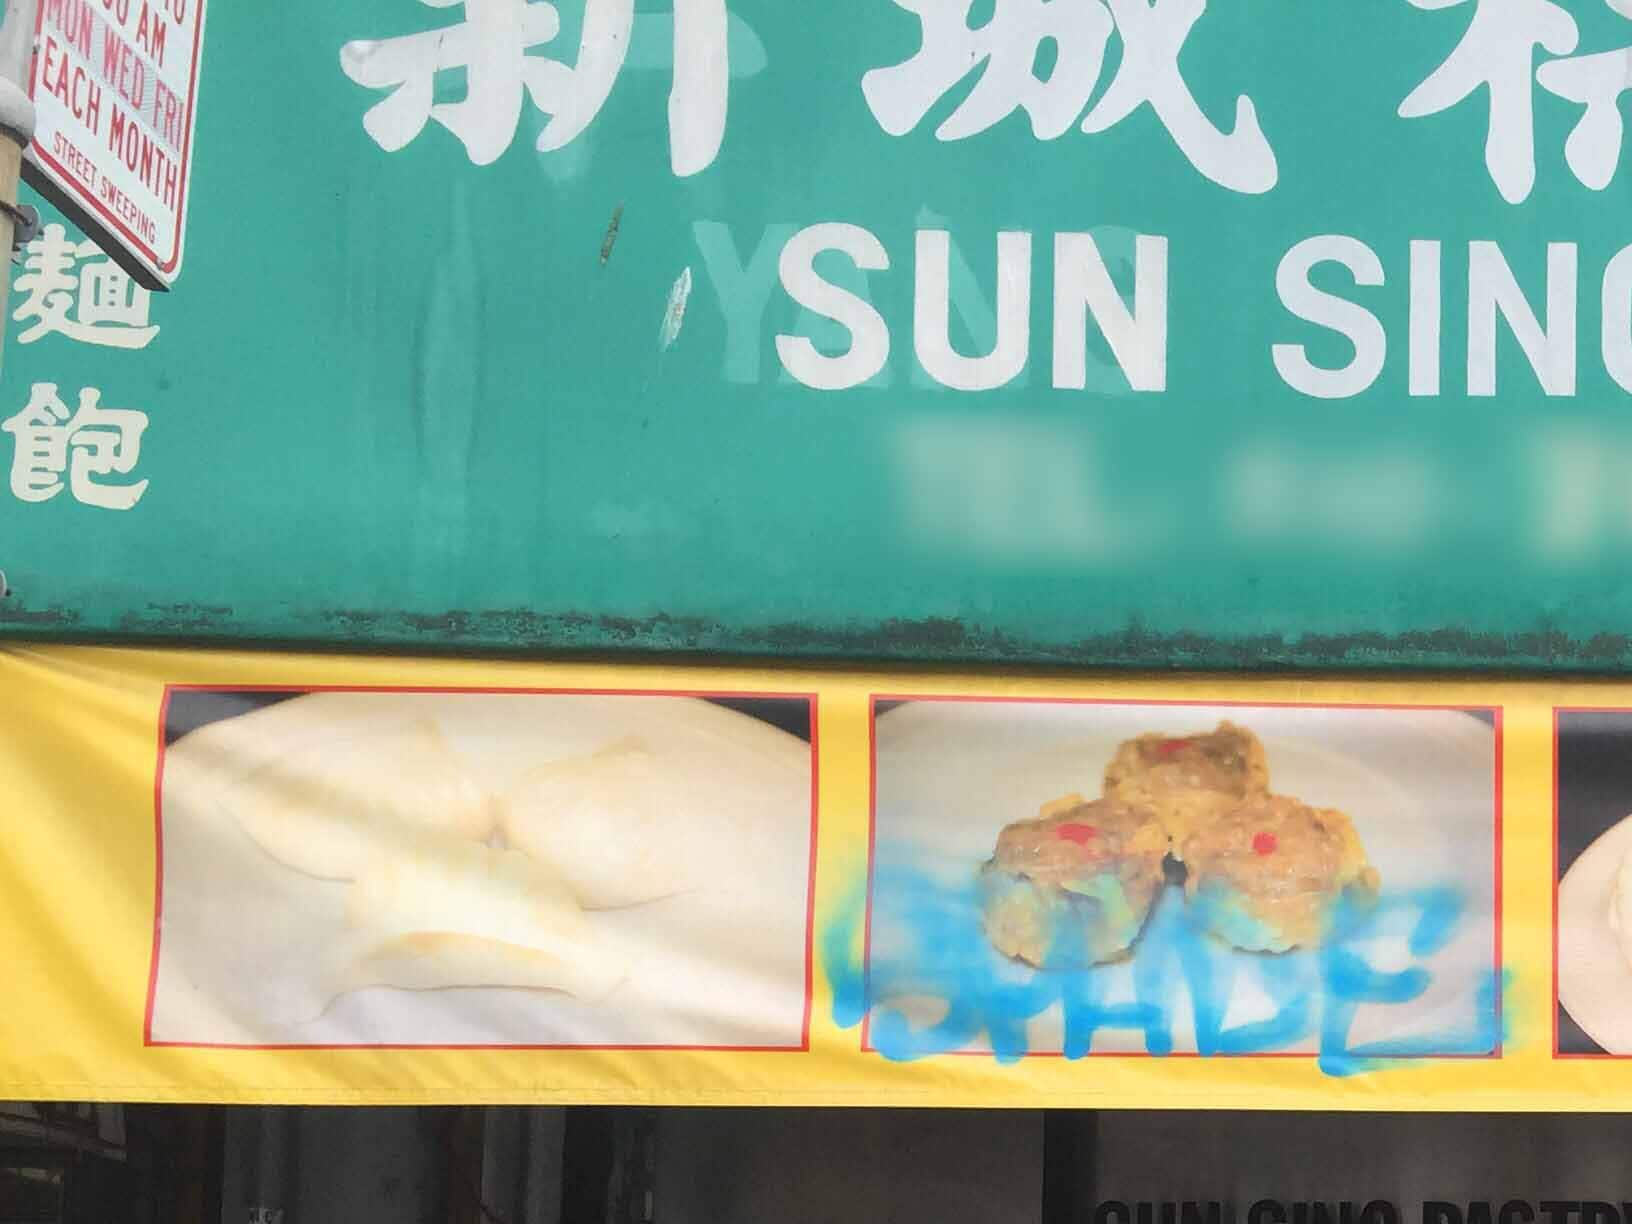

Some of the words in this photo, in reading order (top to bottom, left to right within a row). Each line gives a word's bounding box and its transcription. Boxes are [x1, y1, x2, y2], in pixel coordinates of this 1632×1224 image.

[43, 36, 101, 136] EACH
[109, 103, 177, 211] MONTH
[103, 26, 145, 110] WED
[153, 79, 184, 147] FRI
[53, 131, 97, 188] STREET
[100, 176, 156, 245] SWEEPING
[775, 222, 1169, 391] SUN
